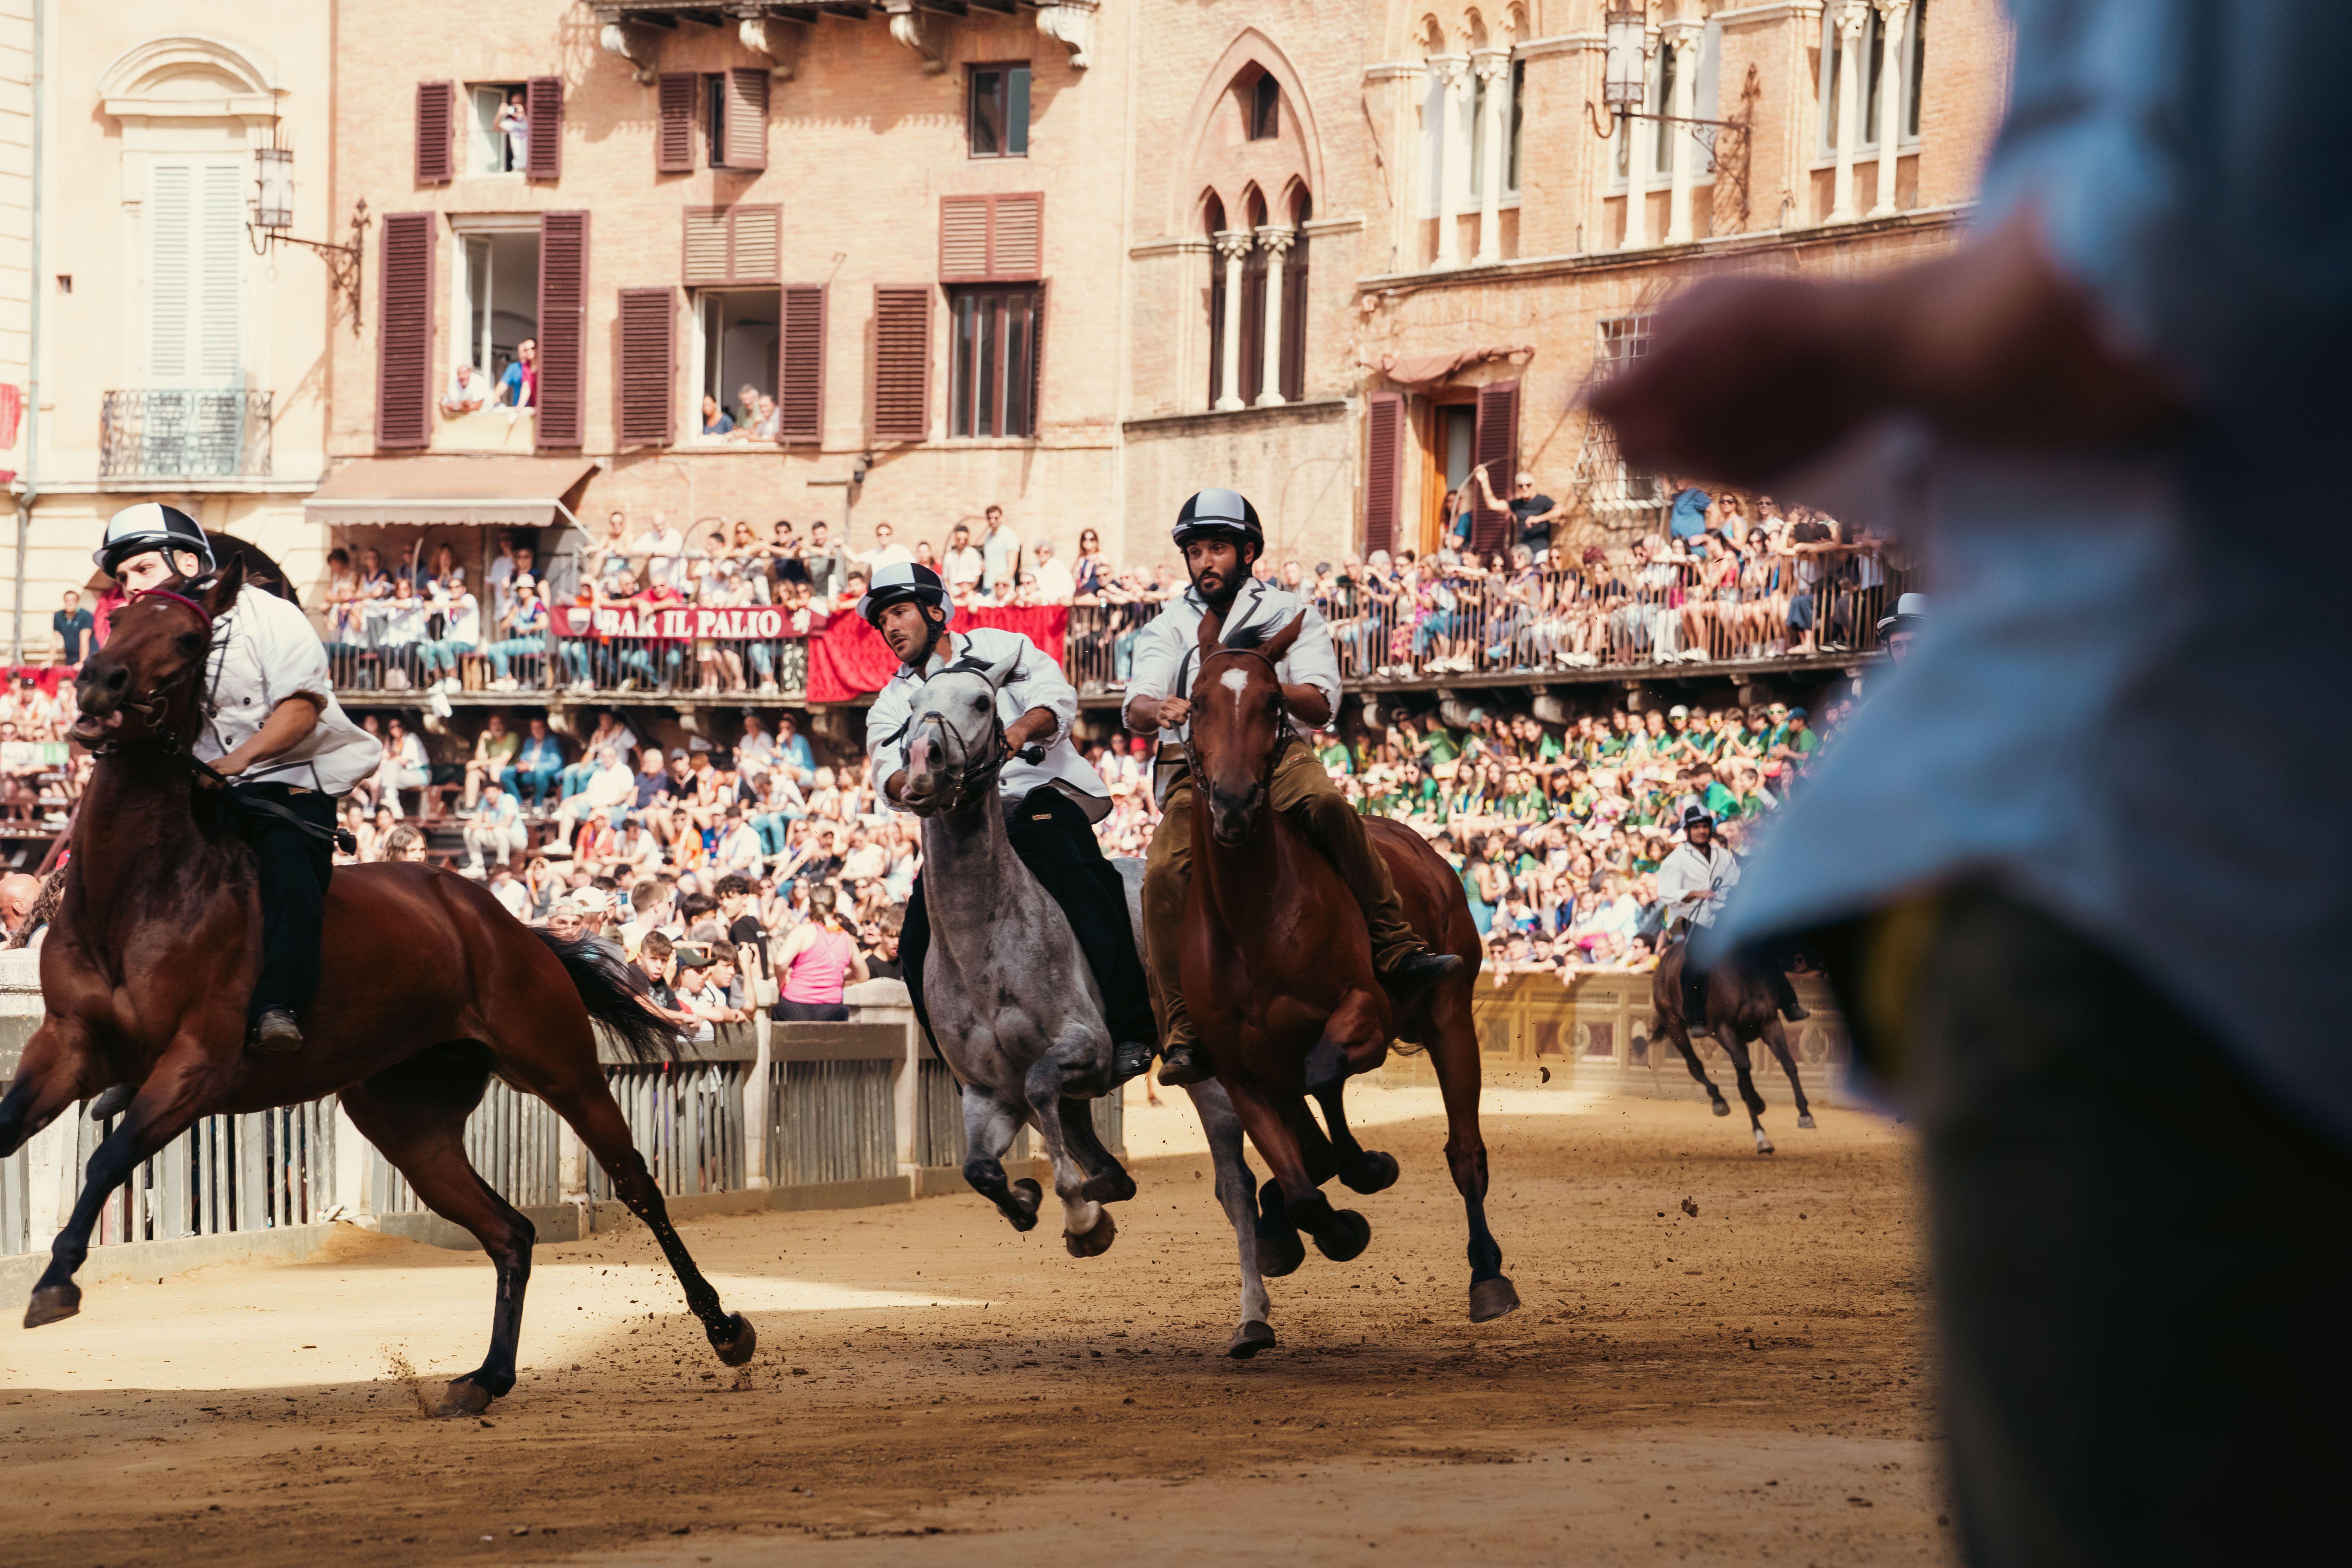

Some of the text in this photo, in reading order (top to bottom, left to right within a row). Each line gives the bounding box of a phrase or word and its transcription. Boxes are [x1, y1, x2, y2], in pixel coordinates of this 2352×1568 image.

[601, 610, 782, 638] BAR IL PALIO
[24, 1218, 29, 1239] A
